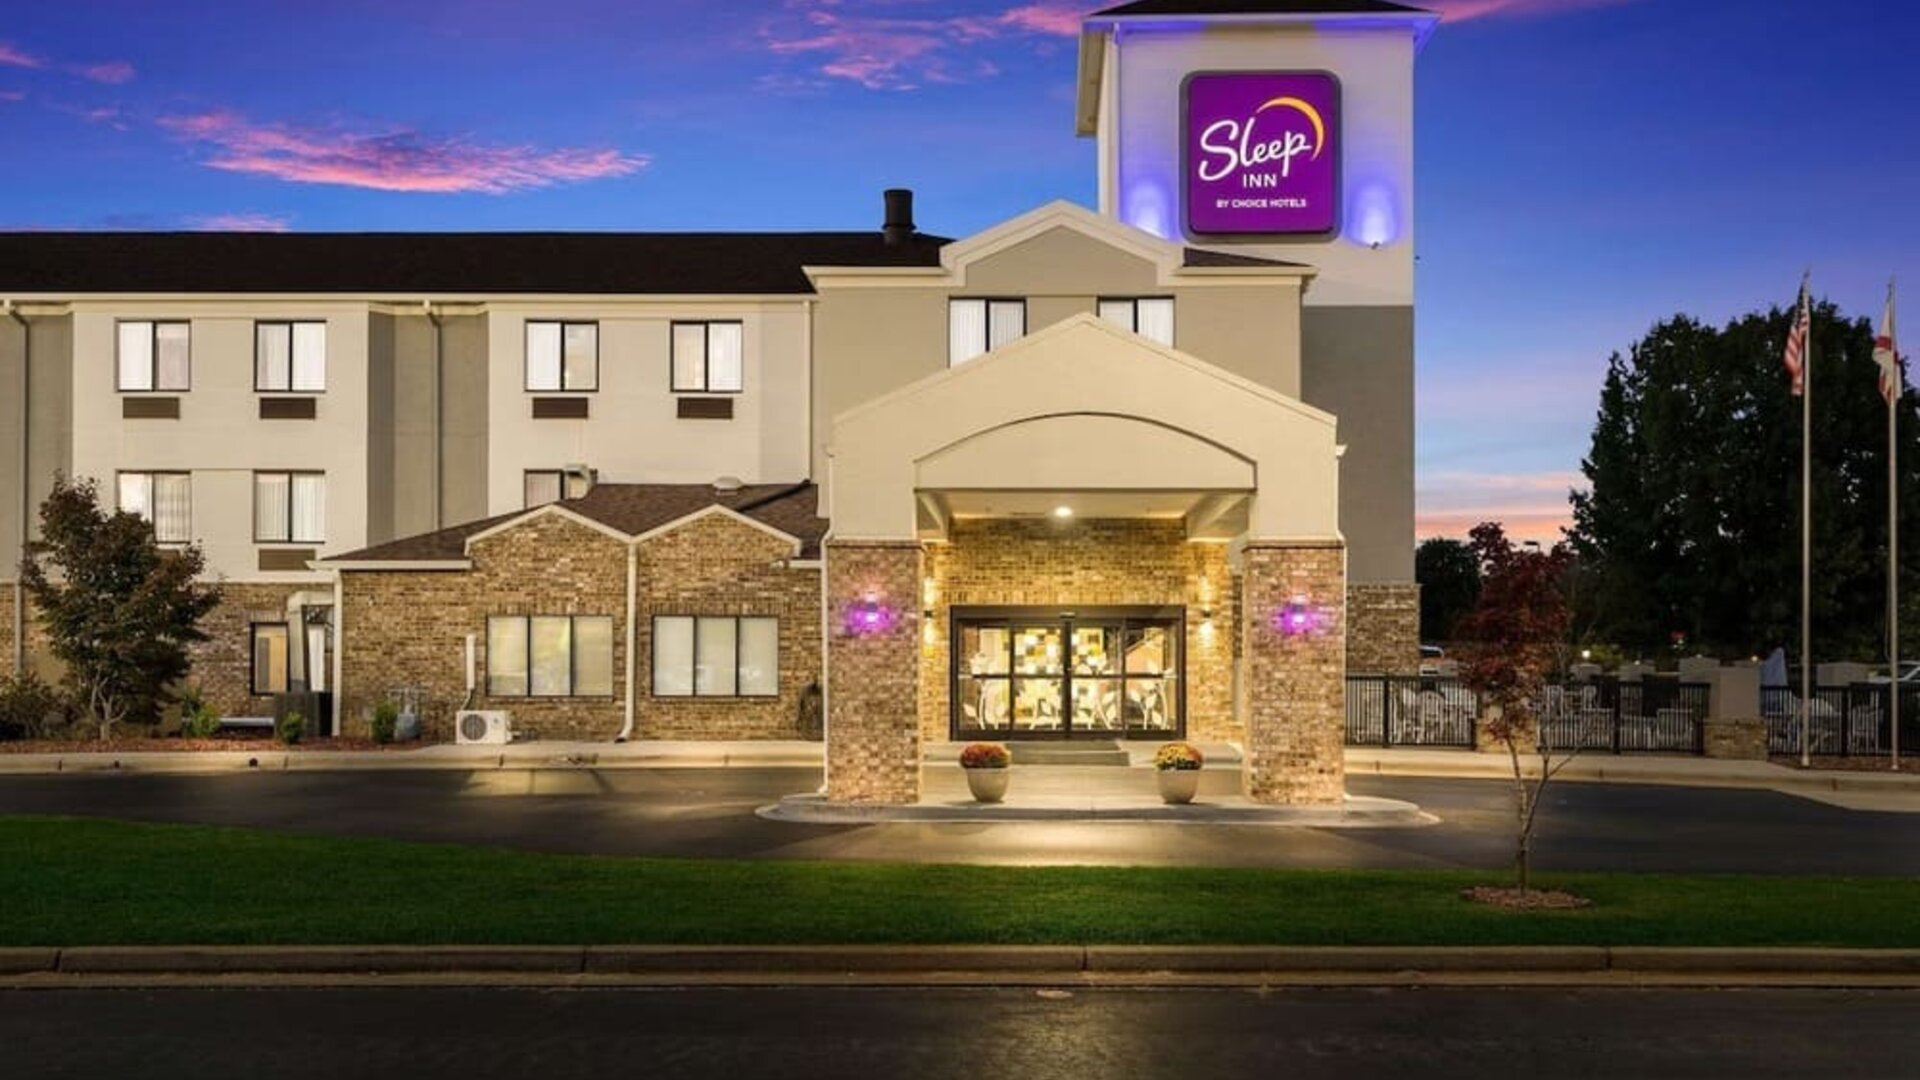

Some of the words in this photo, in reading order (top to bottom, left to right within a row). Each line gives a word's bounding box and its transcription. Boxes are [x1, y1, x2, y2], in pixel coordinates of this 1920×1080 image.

[1198, 117, 1312, 181] Sleep
[1243, 173, 1277, 188] INN
[1216, 199, 1229, 208] BY
[1232, 199, 1268, 208] CHOICE
[1269, 199, 1307, 208] HOTELS
